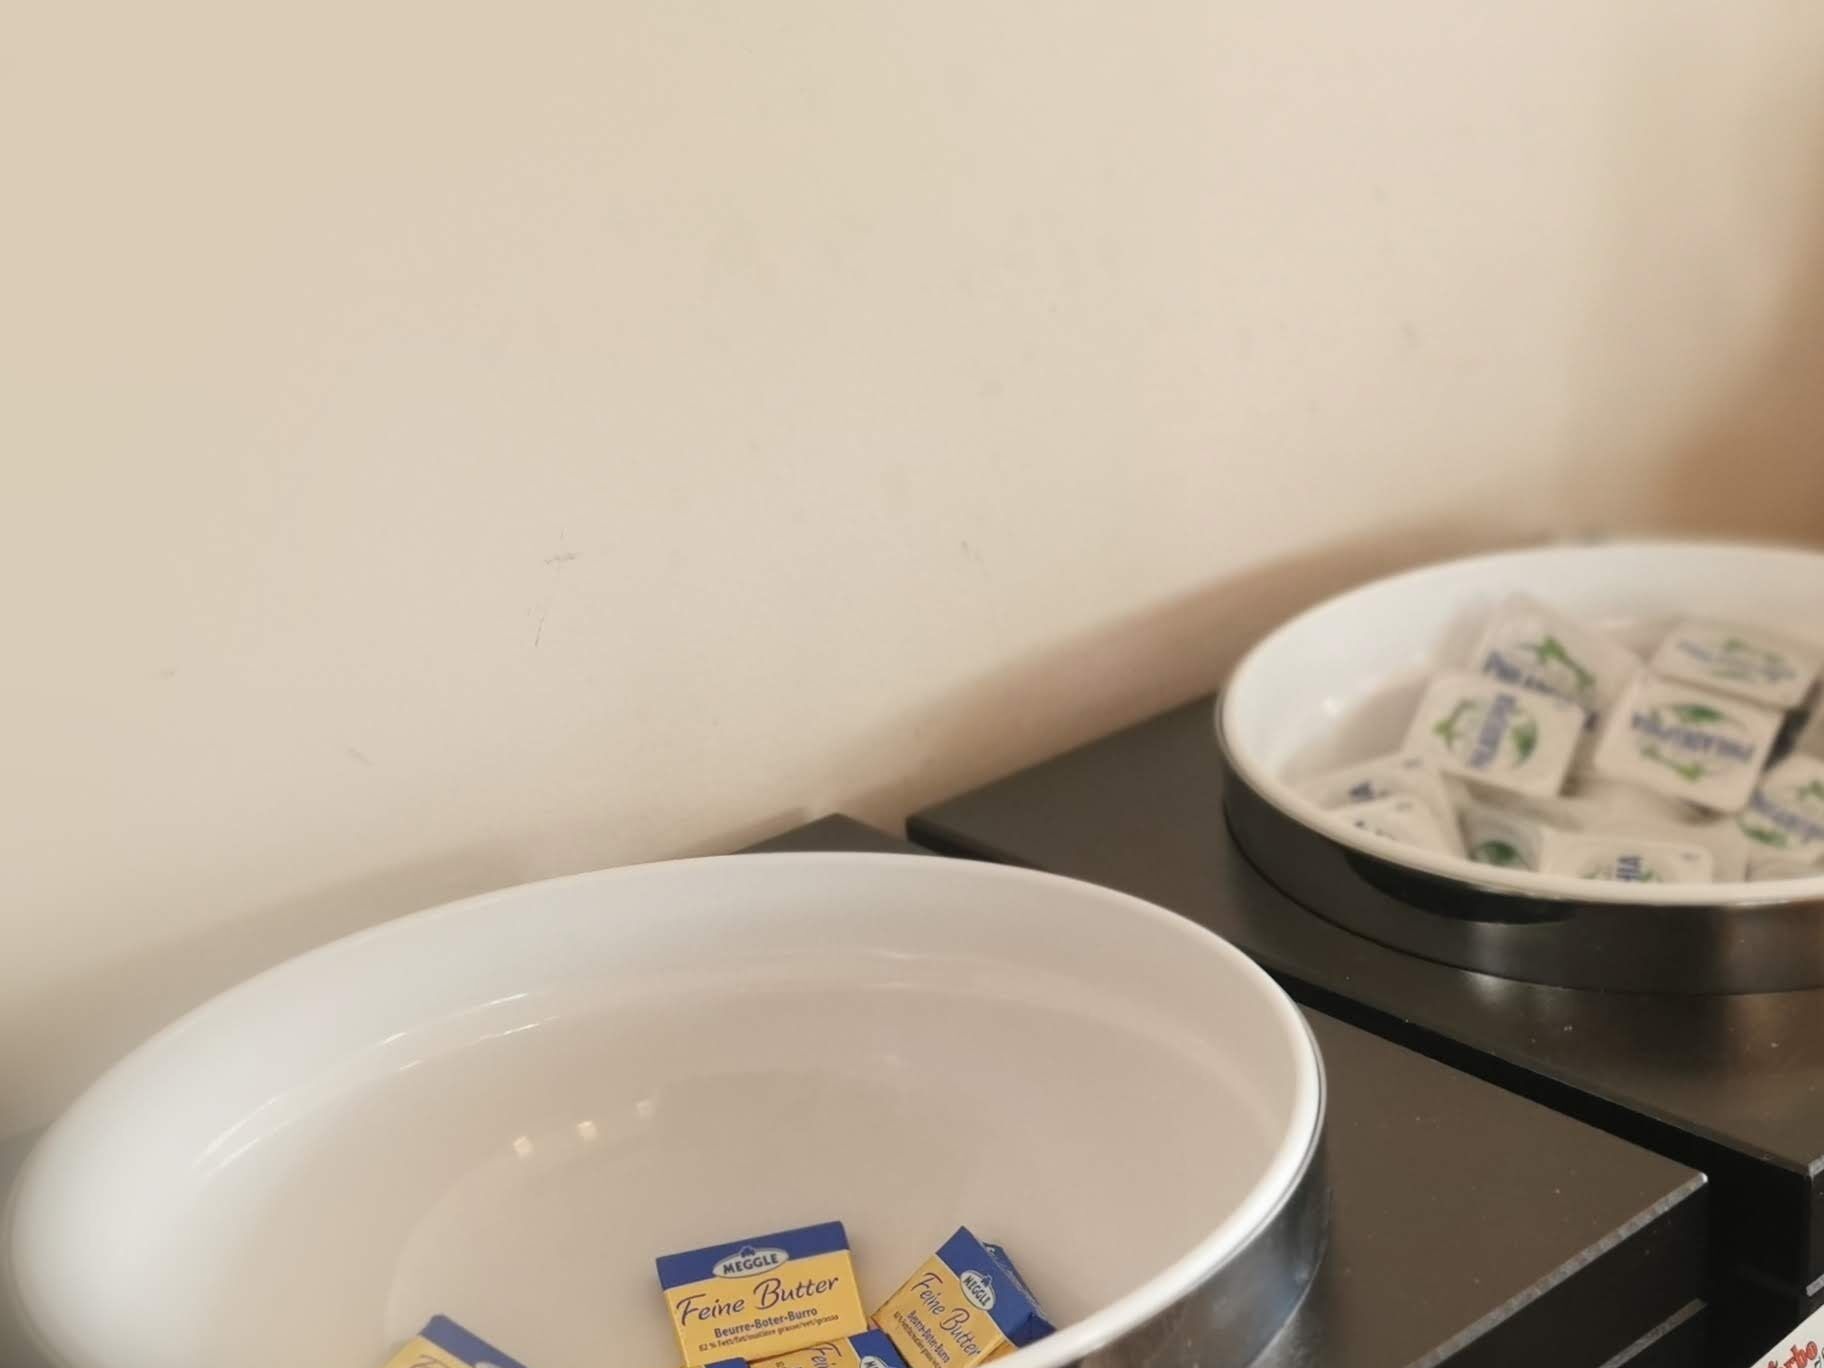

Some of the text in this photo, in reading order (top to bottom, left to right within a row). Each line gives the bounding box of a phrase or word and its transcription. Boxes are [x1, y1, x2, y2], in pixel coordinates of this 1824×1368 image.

[722, 1253, 780, 1275] MEGGLE
[675, 1277, 839, 1326] Feine Butter
[962, 1275, 991, 1307] MEGGLE
[910, 1272, 946, 1316] Feine
[939, 1307, 981, 1357] Butter
